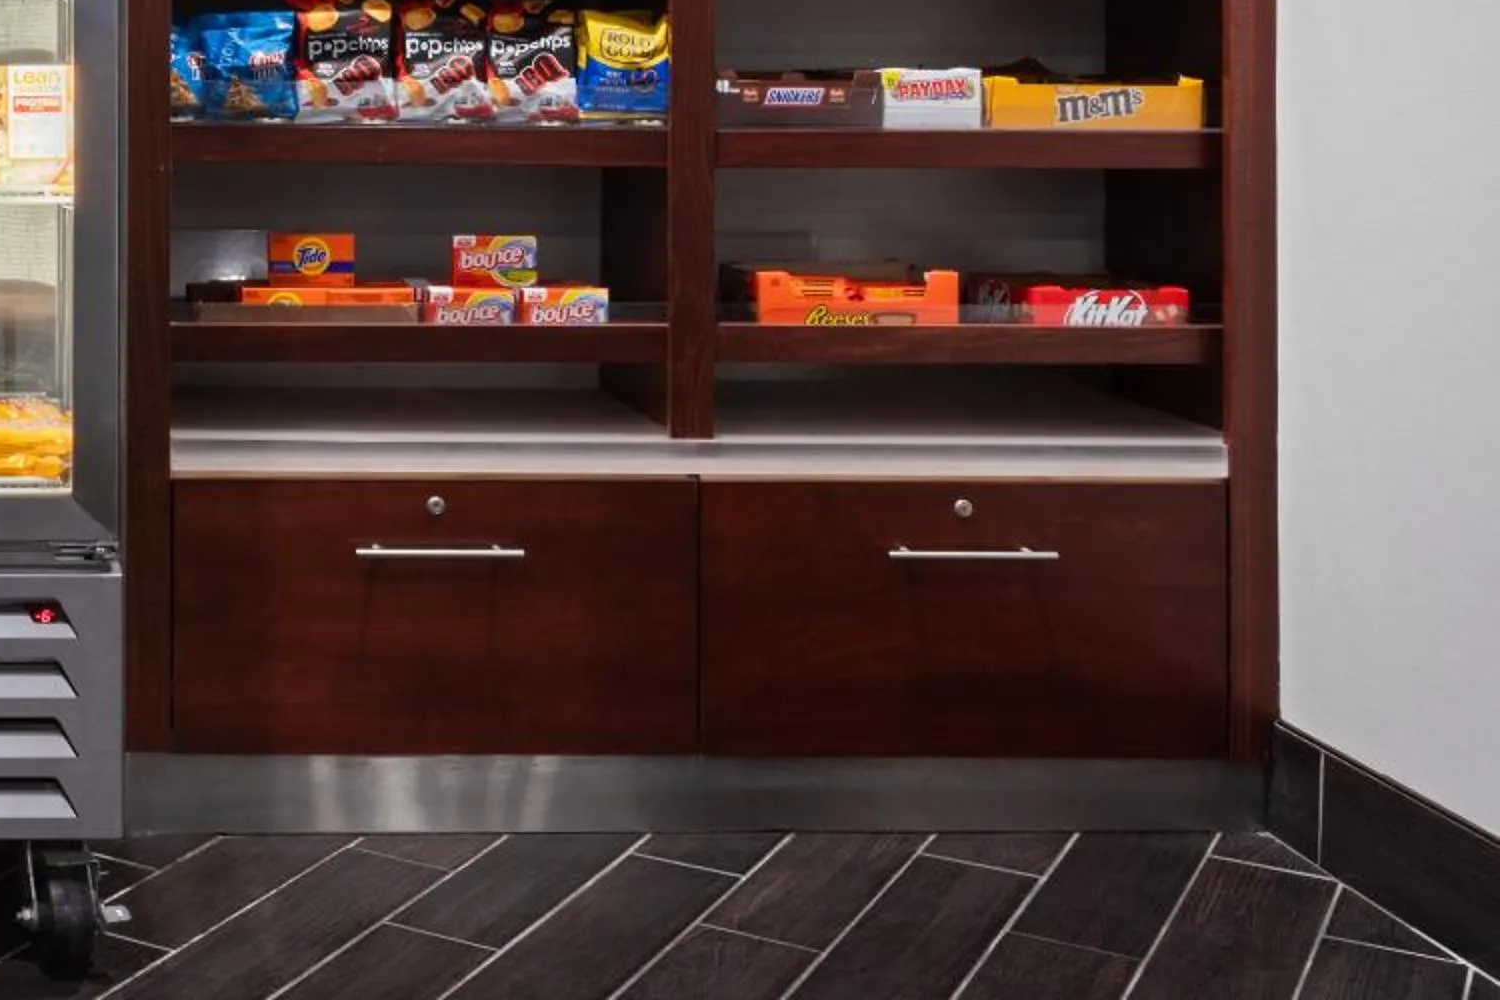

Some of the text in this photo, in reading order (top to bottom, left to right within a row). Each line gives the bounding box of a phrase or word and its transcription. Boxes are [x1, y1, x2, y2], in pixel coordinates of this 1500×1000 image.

[898, 78, 965, 101] PAYDAY
[297, 247, 327, 266] Tide
[460, 247, 524, 269] bounce
[437, 303, 500, 324] bounce
[531, 302, 595, 324] bounce
